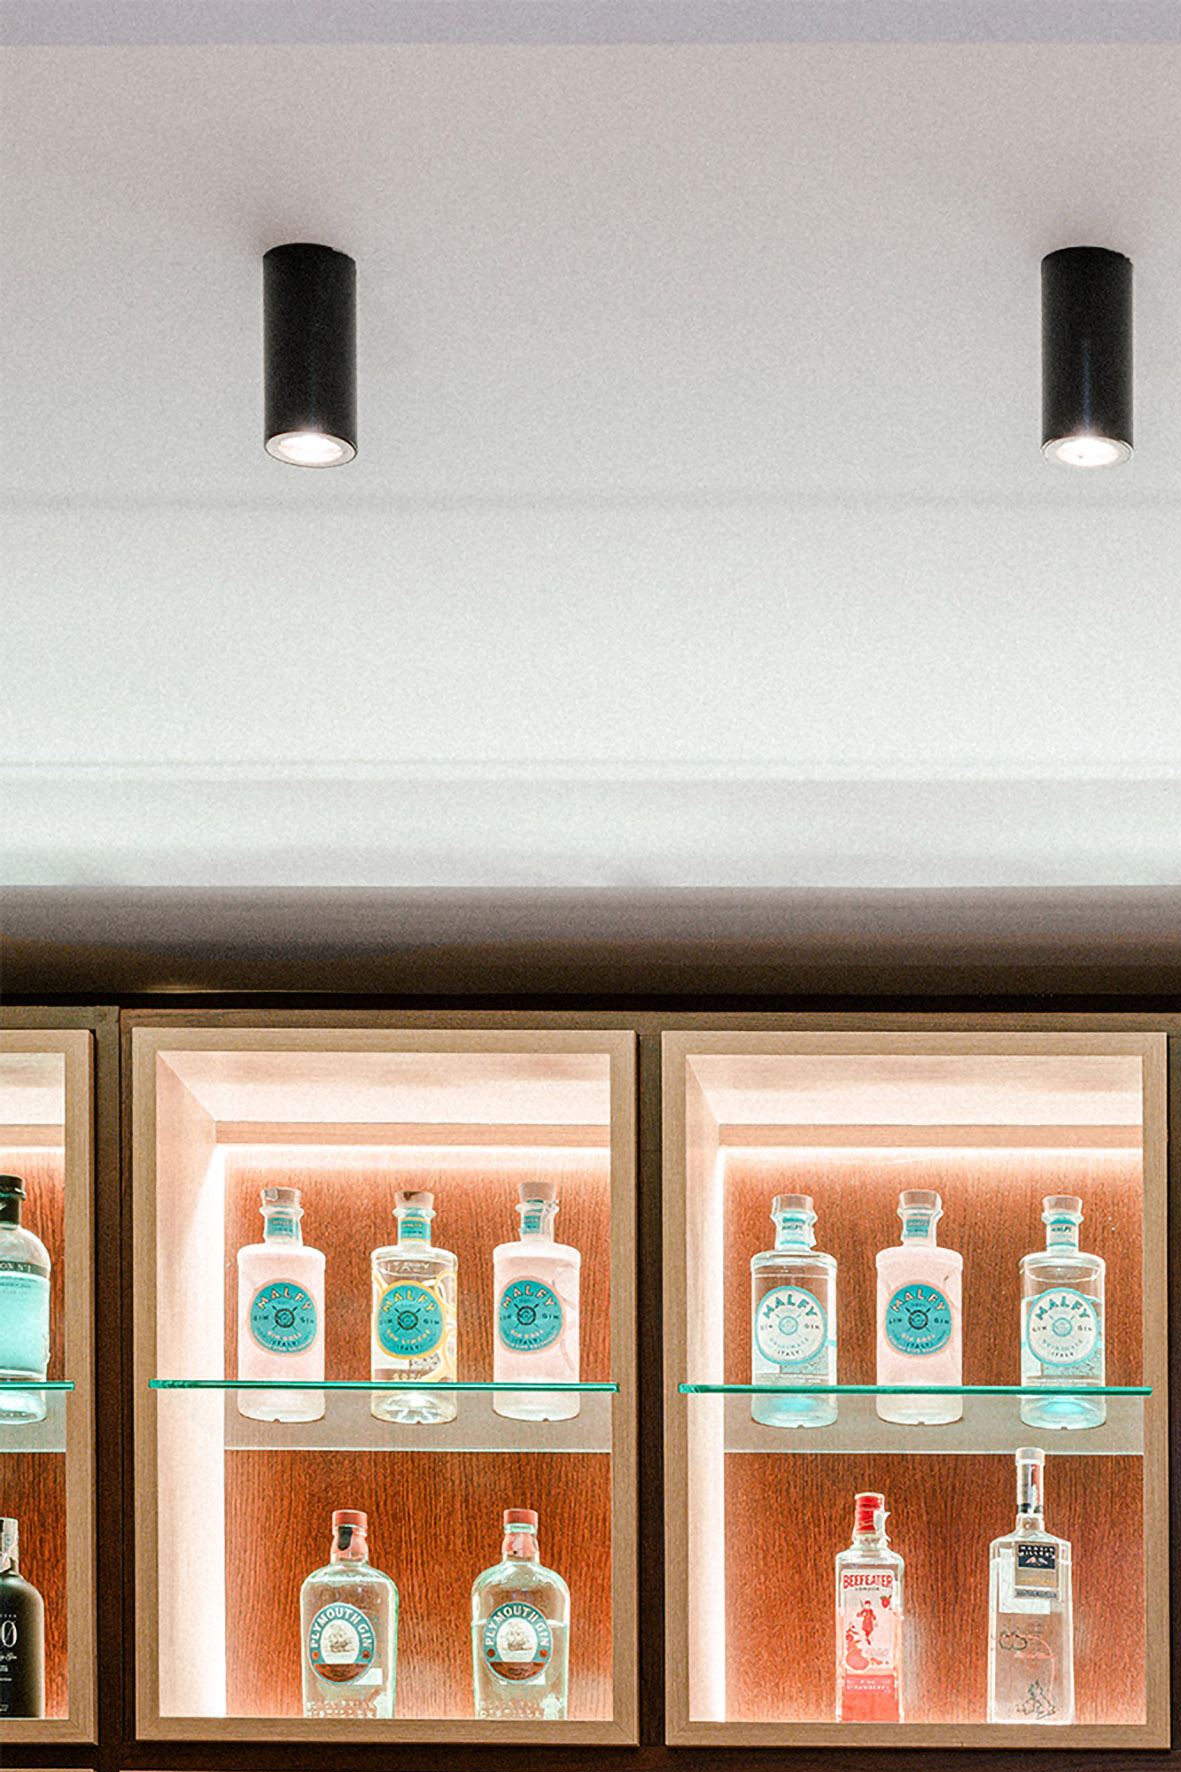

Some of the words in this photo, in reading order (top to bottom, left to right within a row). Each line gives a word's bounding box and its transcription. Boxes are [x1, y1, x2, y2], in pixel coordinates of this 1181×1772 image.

[256, 1286, 313, 1310] MALFY
[382, 1290, 436, 1313] MALFY
[502, 1285, 556, 1309] MALFY
[763, 1294, 818, 1319] MALFY
[891, 1289, 946, 1312] MALFY
[1035, 1296, 1090, 1320] MALFY
[843, 1574, 893, 1590] BEEFEATER
[311, 1606, 361, 1648] PLYMOUTH
[358, 1623, 373, 1649] GIN
[485, 1605, 540, 1646] PLYMOUTH
[535, 1622, 550, 1647] GIN
